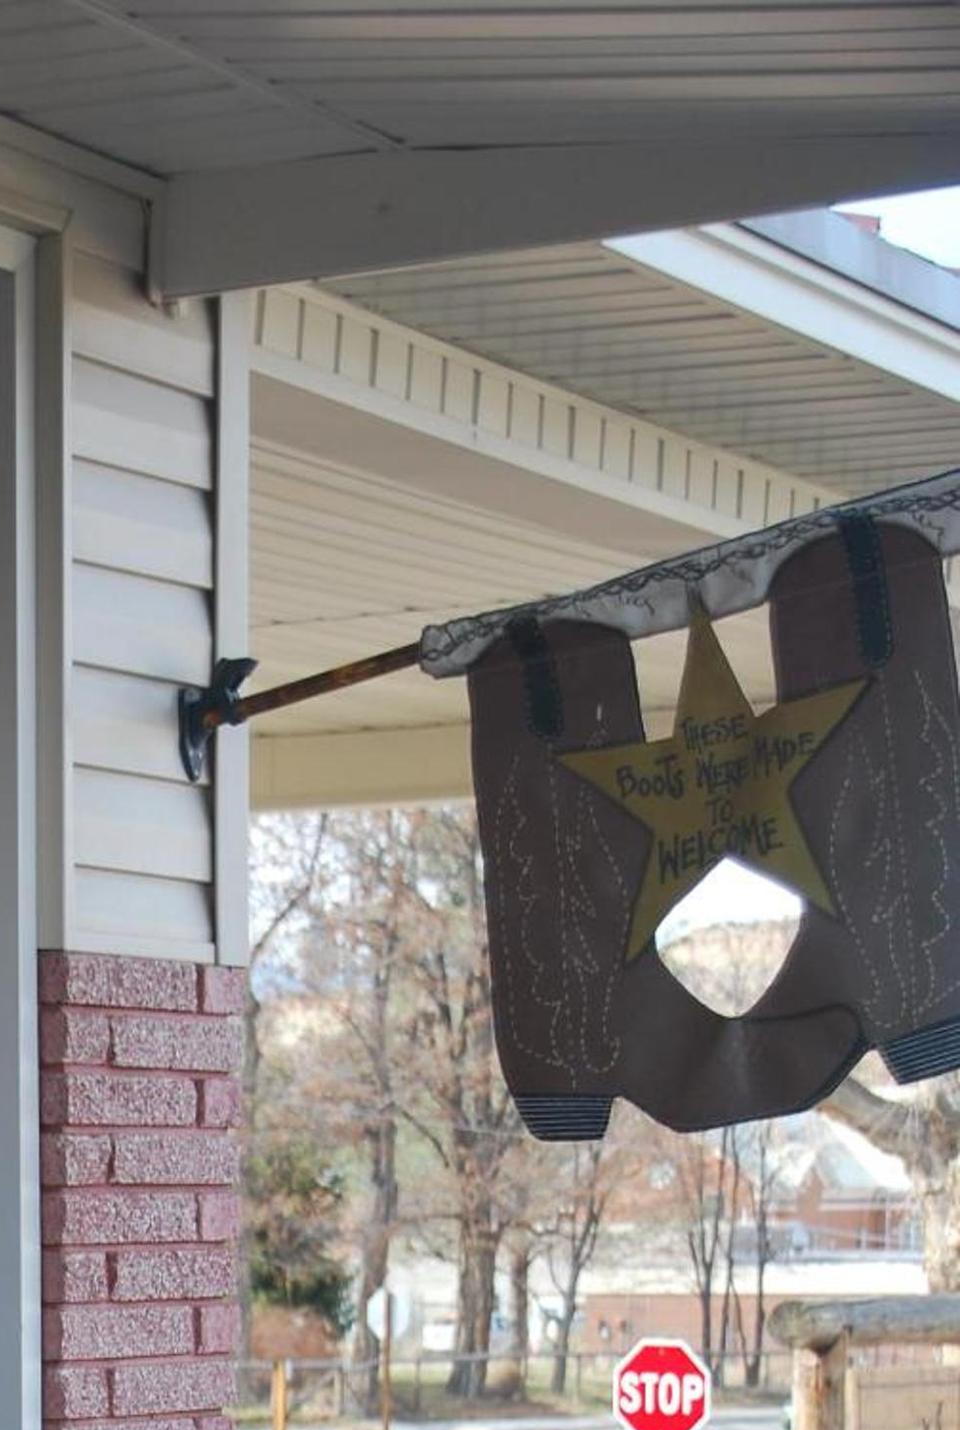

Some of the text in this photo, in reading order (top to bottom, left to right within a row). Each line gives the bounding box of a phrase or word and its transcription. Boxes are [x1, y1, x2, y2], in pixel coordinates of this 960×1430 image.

[682, 714, 748, 753] THESE
[695, 753, 750, 793] WERE
[752, 731, 815, 780] MADE
[705, 797, 734, 826] TO
[657, 814, 783, 885] WELCOME
[619, 1371, 704, 1416] STOP
